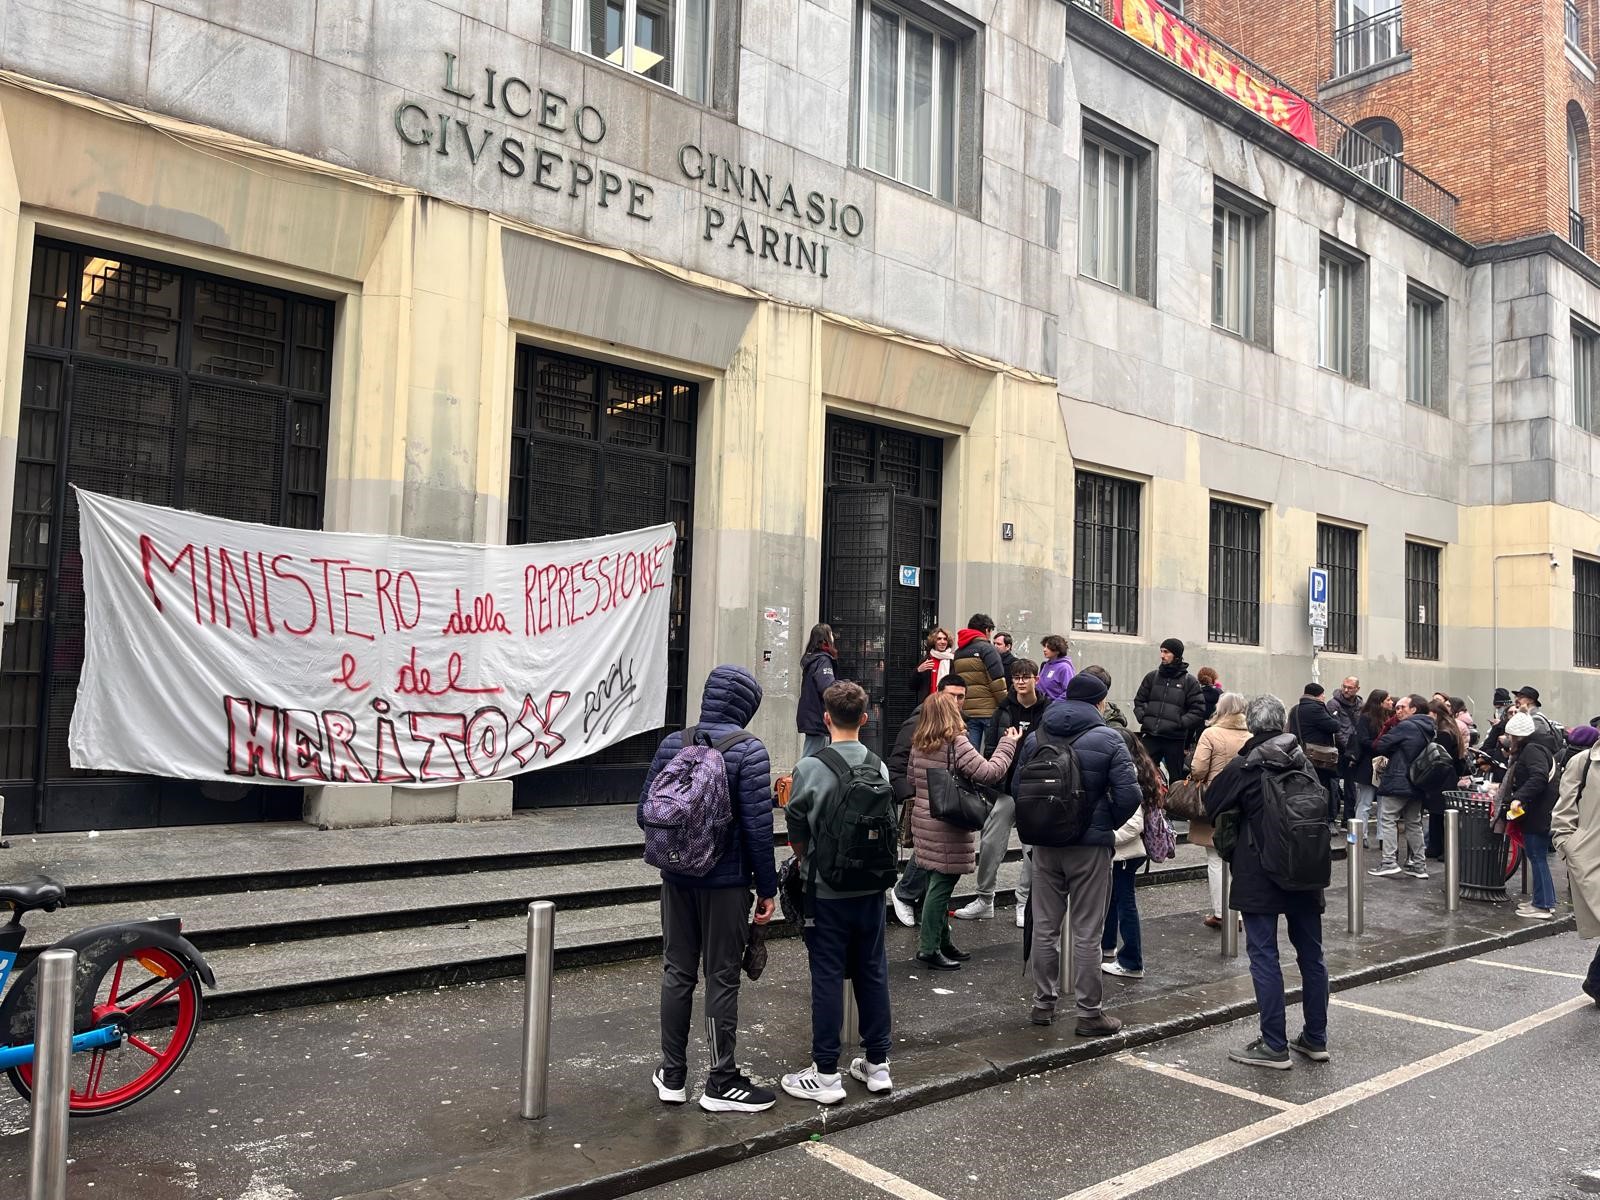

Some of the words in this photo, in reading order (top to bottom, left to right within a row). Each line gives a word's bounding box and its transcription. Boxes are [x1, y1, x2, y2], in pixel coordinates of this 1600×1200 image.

[395, 104, 656, 222] GIVSEPPE
[703, 205, 830, 278] PARINI
[442, 52, 606, 144] LICEO
[678, 144, 864, 237] GINNASIO
[140, 534, 420, 641] MINISTERO
[442, 588, 511, 635] della
[525, 540, 672, 636] REPRESSIONE
[1314, 575, 1324, 599] P
[333, 653, 370, 692] e
[394, 646, 504, 695] del
